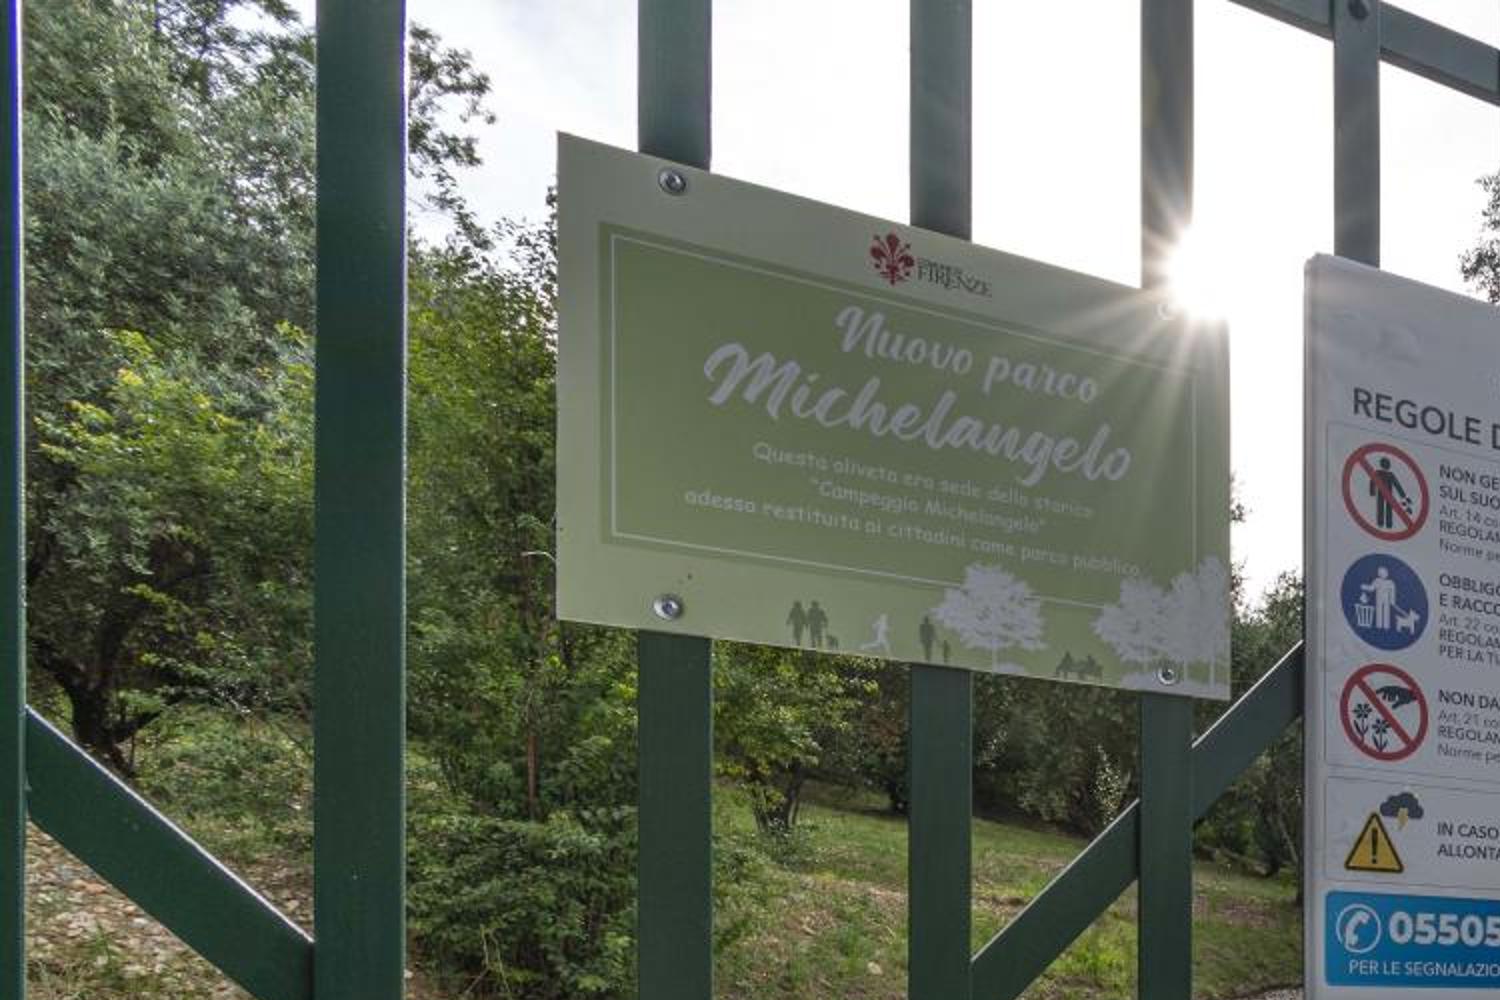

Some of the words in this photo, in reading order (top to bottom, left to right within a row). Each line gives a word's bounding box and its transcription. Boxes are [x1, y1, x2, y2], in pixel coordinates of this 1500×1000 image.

[917, 263, 992, 298] FIRENZE
[835, 306, 973, 376] Nuovo
[983, 352, 1098, 403] parco
[703, 343, 1132, 486] Michelangelo
[1353, 387, 1481, 445] REGOLE
[752, 442, 829, 470] Questo
[941, 479, 979, 498] sede
[1440, 464, 1475, 485] NON
[1440, 485, 1466, 502] SUL
[685, 489, 756, 513] adesso
[888, 522, 966, 547] cittadini
[970, 537, 1017, 555] come
[1020, 546, 1068, 566] parco
[1440, 539, 1483, 557] Norme
[1440, 593, 1448, 607] E
[1440, 645, 1462, 659] PER
[1467, 649, 1484, 663] LA
[1439, 689, 1475, 708] NON
[1439, 743, 1482, 760] Norme
[1437, 822, 1453, 836] IN
[1458, 824, 1499, 840] CASO
[1350, 959, 1379, 976] PER
[1383, 960, 1401, 976] LE
